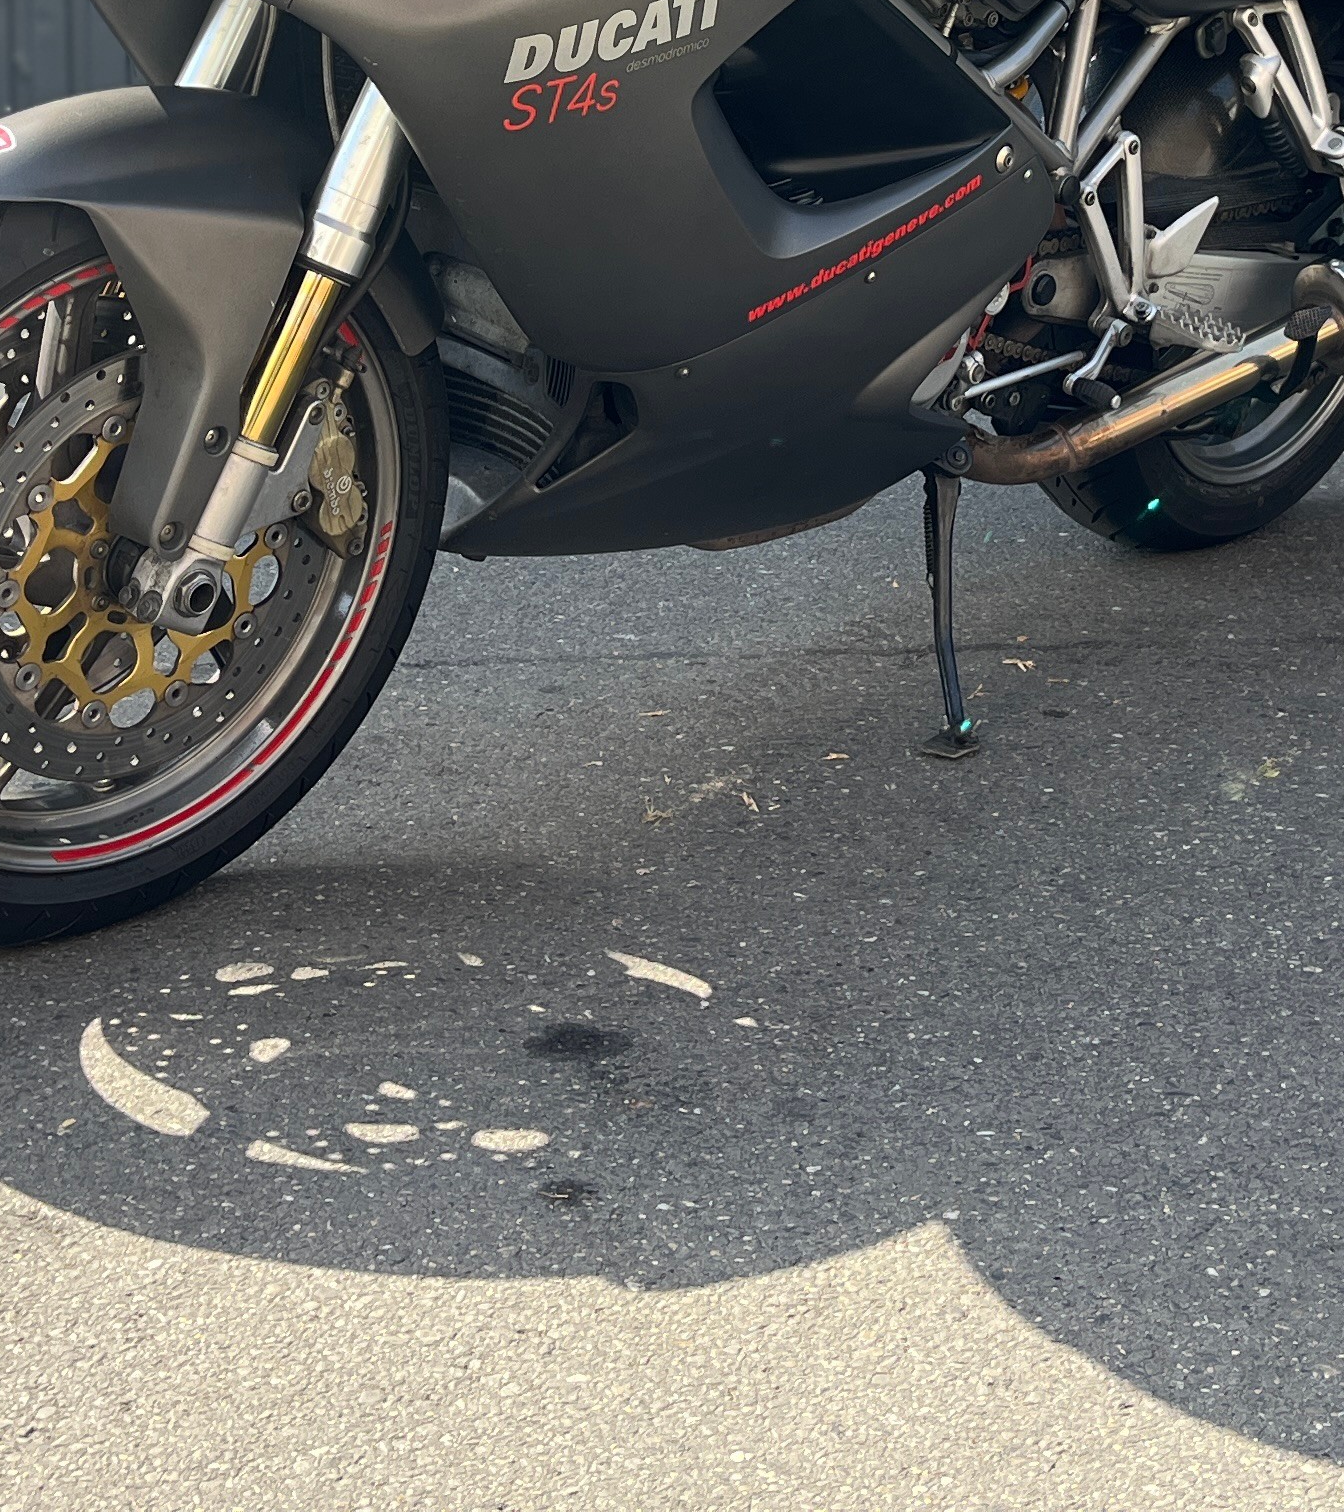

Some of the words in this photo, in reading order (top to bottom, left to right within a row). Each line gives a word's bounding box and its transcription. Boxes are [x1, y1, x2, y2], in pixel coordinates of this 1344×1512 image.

[626, 37, 710, 73] desmodromico
[748, 174, 983, 322] www.ducatigeneve.com
[323, 467, 340, 516] brembo
